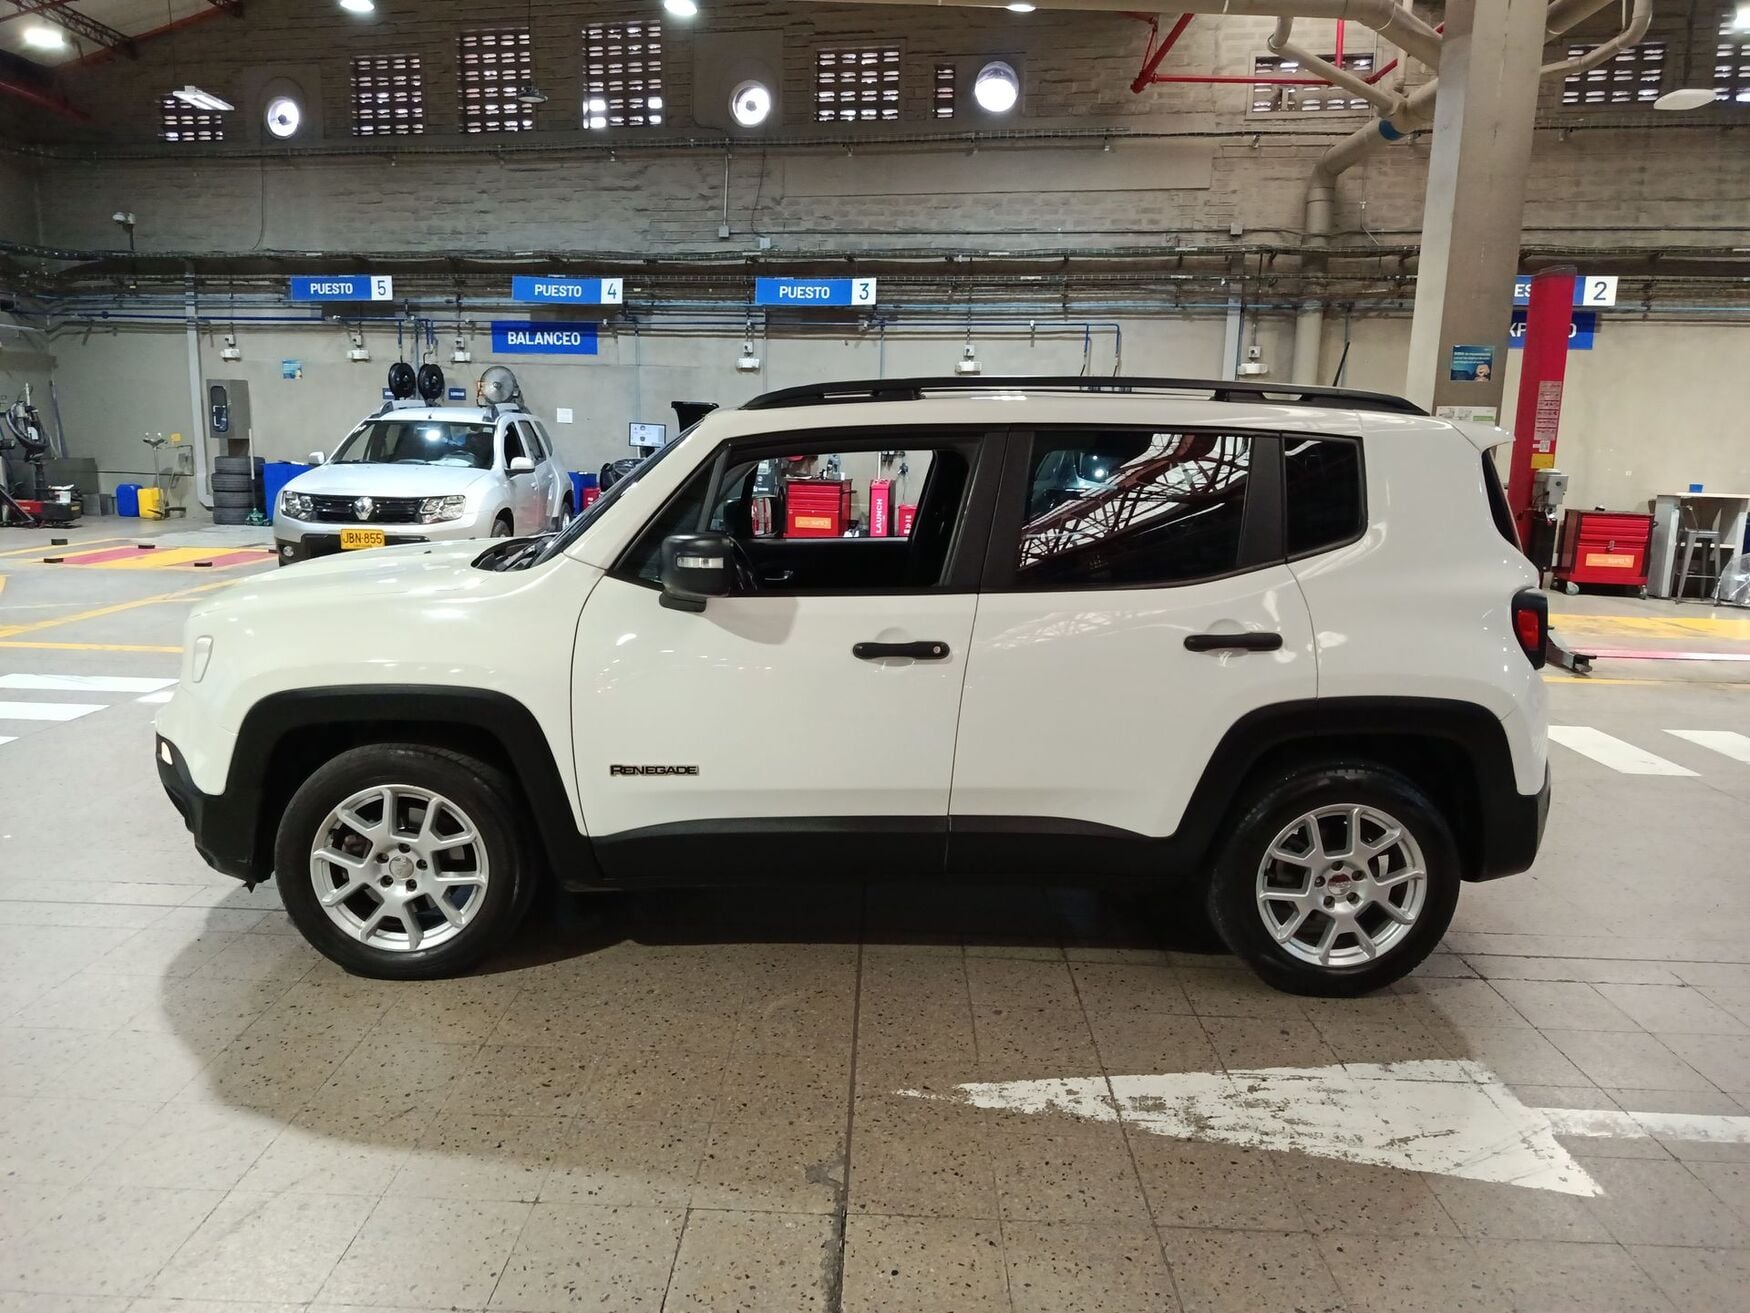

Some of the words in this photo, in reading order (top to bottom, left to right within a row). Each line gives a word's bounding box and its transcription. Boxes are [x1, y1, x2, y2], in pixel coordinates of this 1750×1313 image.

[310, 283, 353, 294] PUESTO
[377, 280, 387, 296] 5
[534, 284, 582, 297] PUESTO
[607, 283, 617, 299] 4
[779, 286, 830, 299] PUESTO
[859, 283, 869, 300] 3
[1593, 281, 1607, 300] 2
[507, 331, 581, 345] BALANCEO
[875, 498, 883, 534] LAUNCH
[610, 765, 699, 776] RENEGADE
